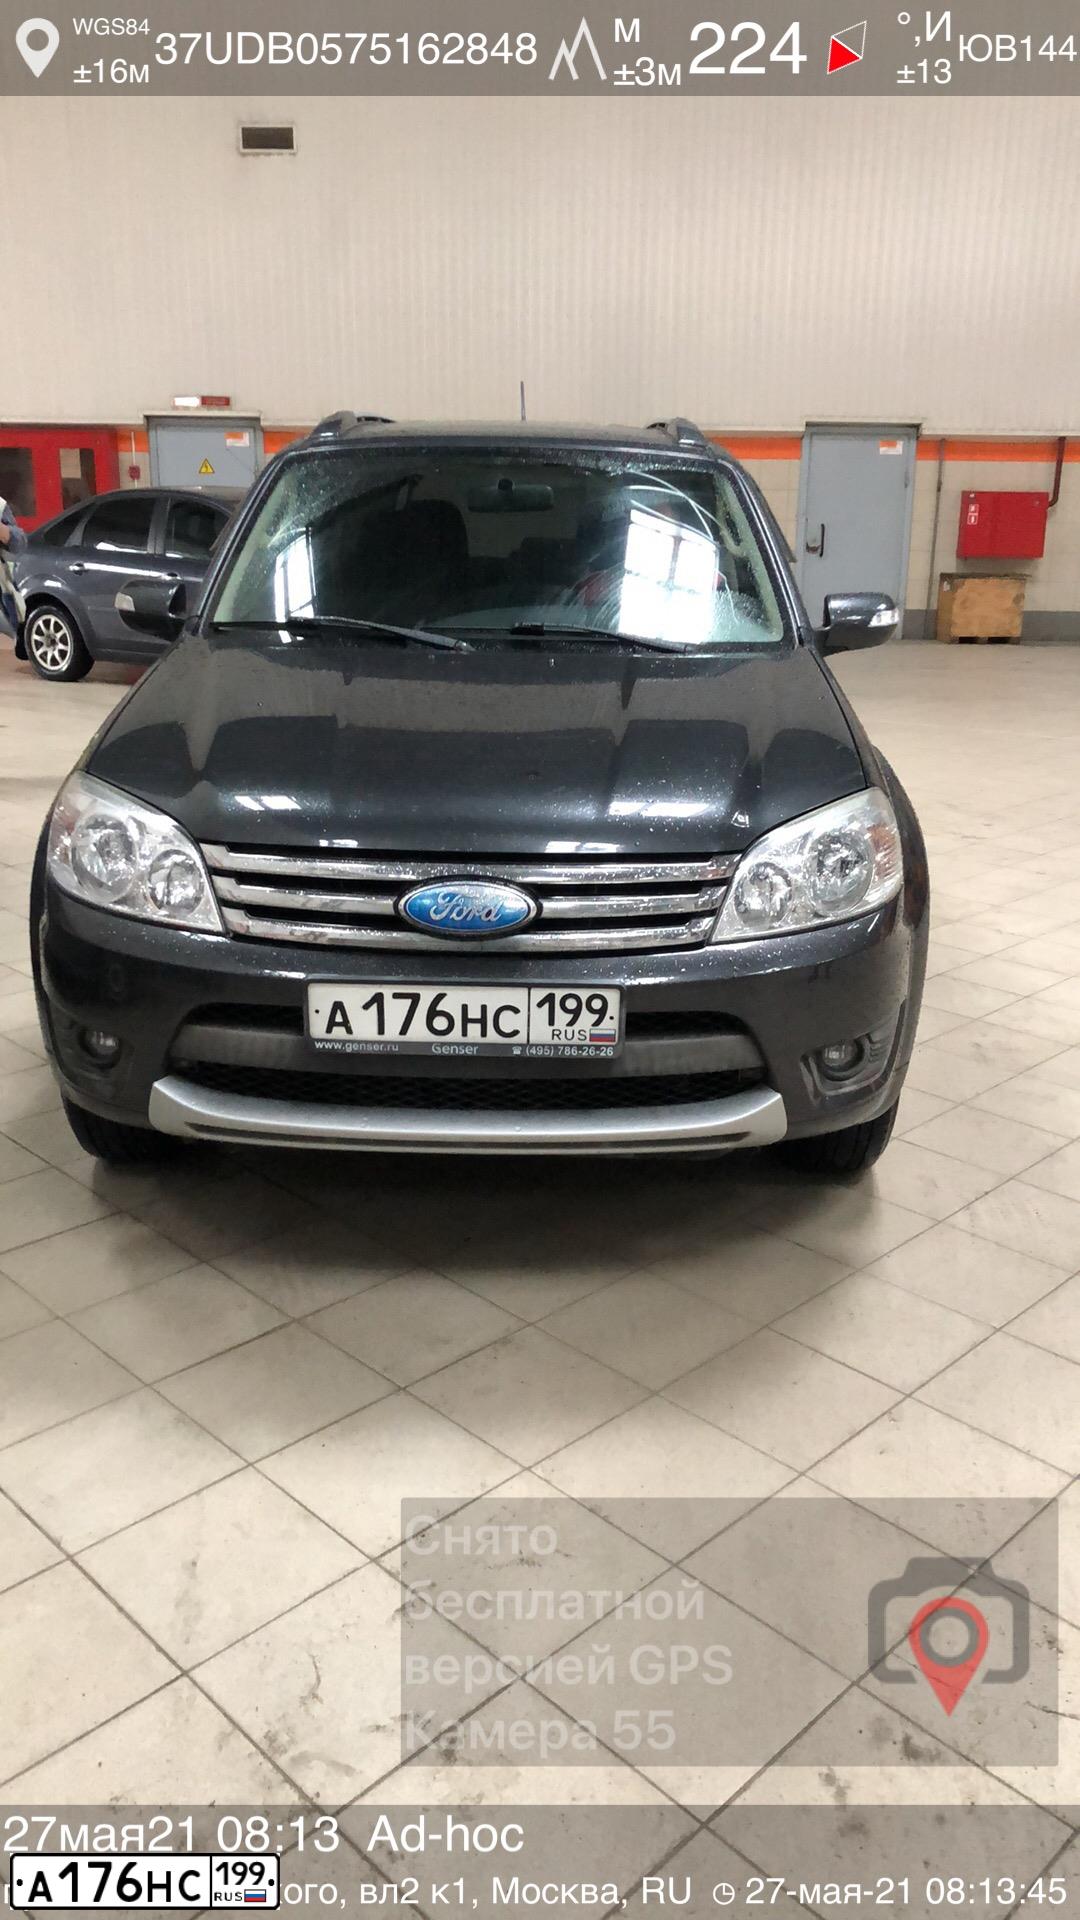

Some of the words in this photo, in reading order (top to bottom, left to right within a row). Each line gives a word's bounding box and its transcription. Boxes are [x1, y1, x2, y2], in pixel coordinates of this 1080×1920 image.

[430, 891, 502, 923] Ford
[536, 992, 610, 1028] 199
[551, 1028, 588, 1042] RUS
[314, 1040, 399, 1053] www.genser.ru
[431, 1042, 479, 1056] Genser
[526, 1046, 555, 1057] (495)
[557, 1046, 614, 1057] 786-26-26
